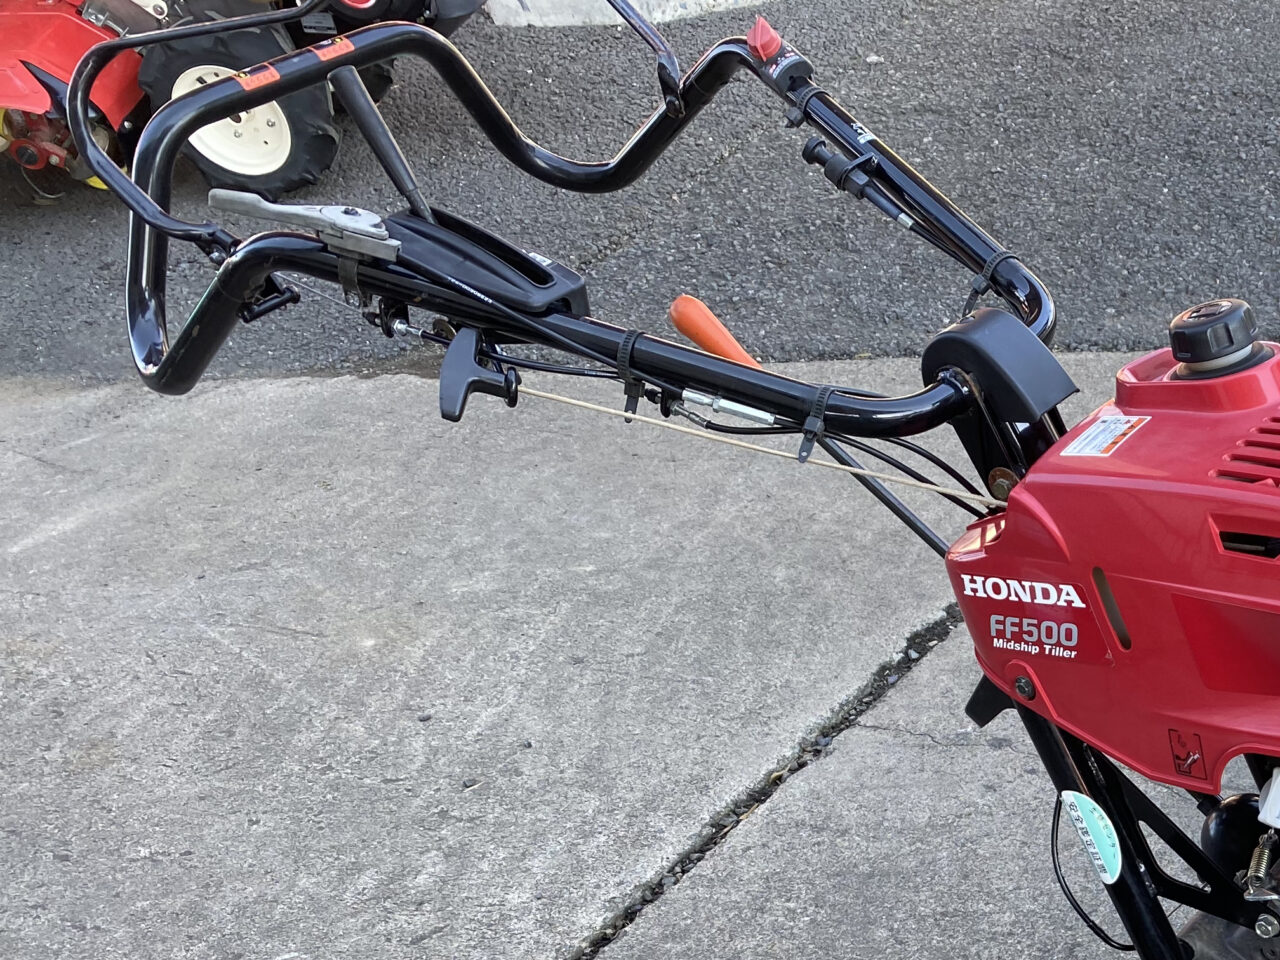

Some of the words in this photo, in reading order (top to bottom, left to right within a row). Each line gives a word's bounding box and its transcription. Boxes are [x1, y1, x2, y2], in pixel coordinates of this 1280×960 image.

[961, 574, 1087, 608] HONDA
[990, 614, 1078, 647] FF500
[993, 638, 1039, 654] Midship
[1043, 644, 1077, 658] Tiller
